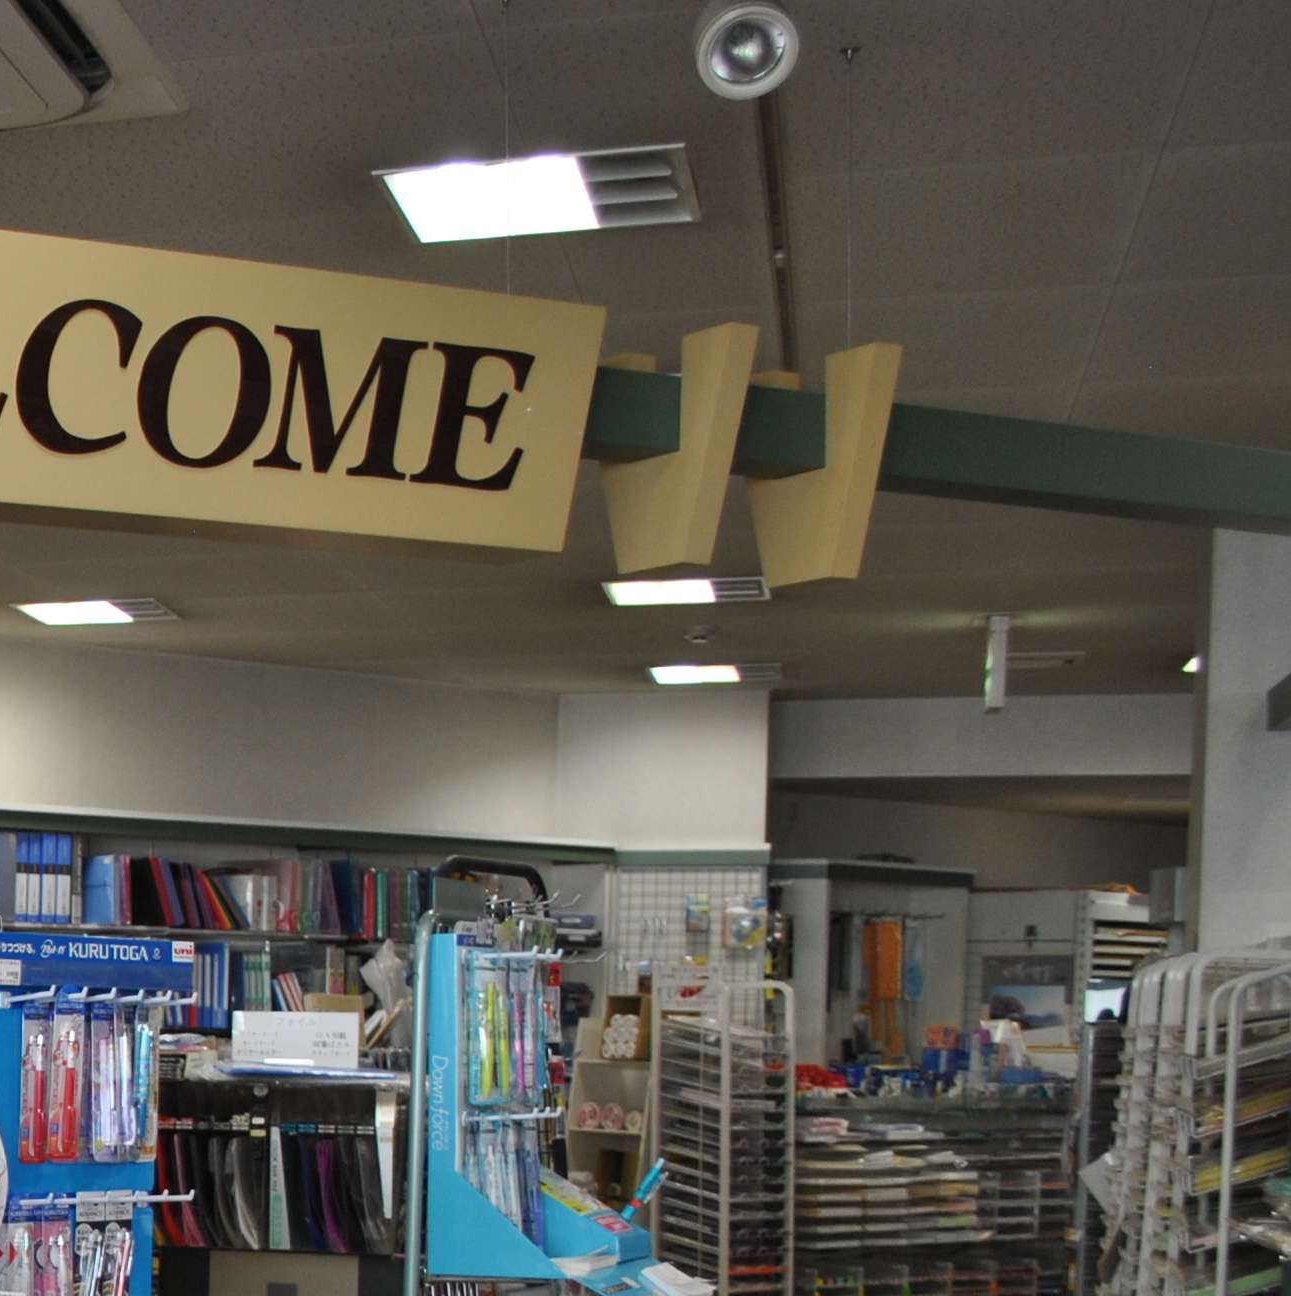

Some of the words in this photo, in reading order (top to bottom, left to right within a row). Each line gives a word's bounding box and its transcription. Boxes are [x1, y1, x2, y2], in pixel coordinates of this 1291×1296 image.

[173, 943, 193, 956] uni
[431, 1055, 450, 1103] Down
[431, 1106, 451, 1152] force
